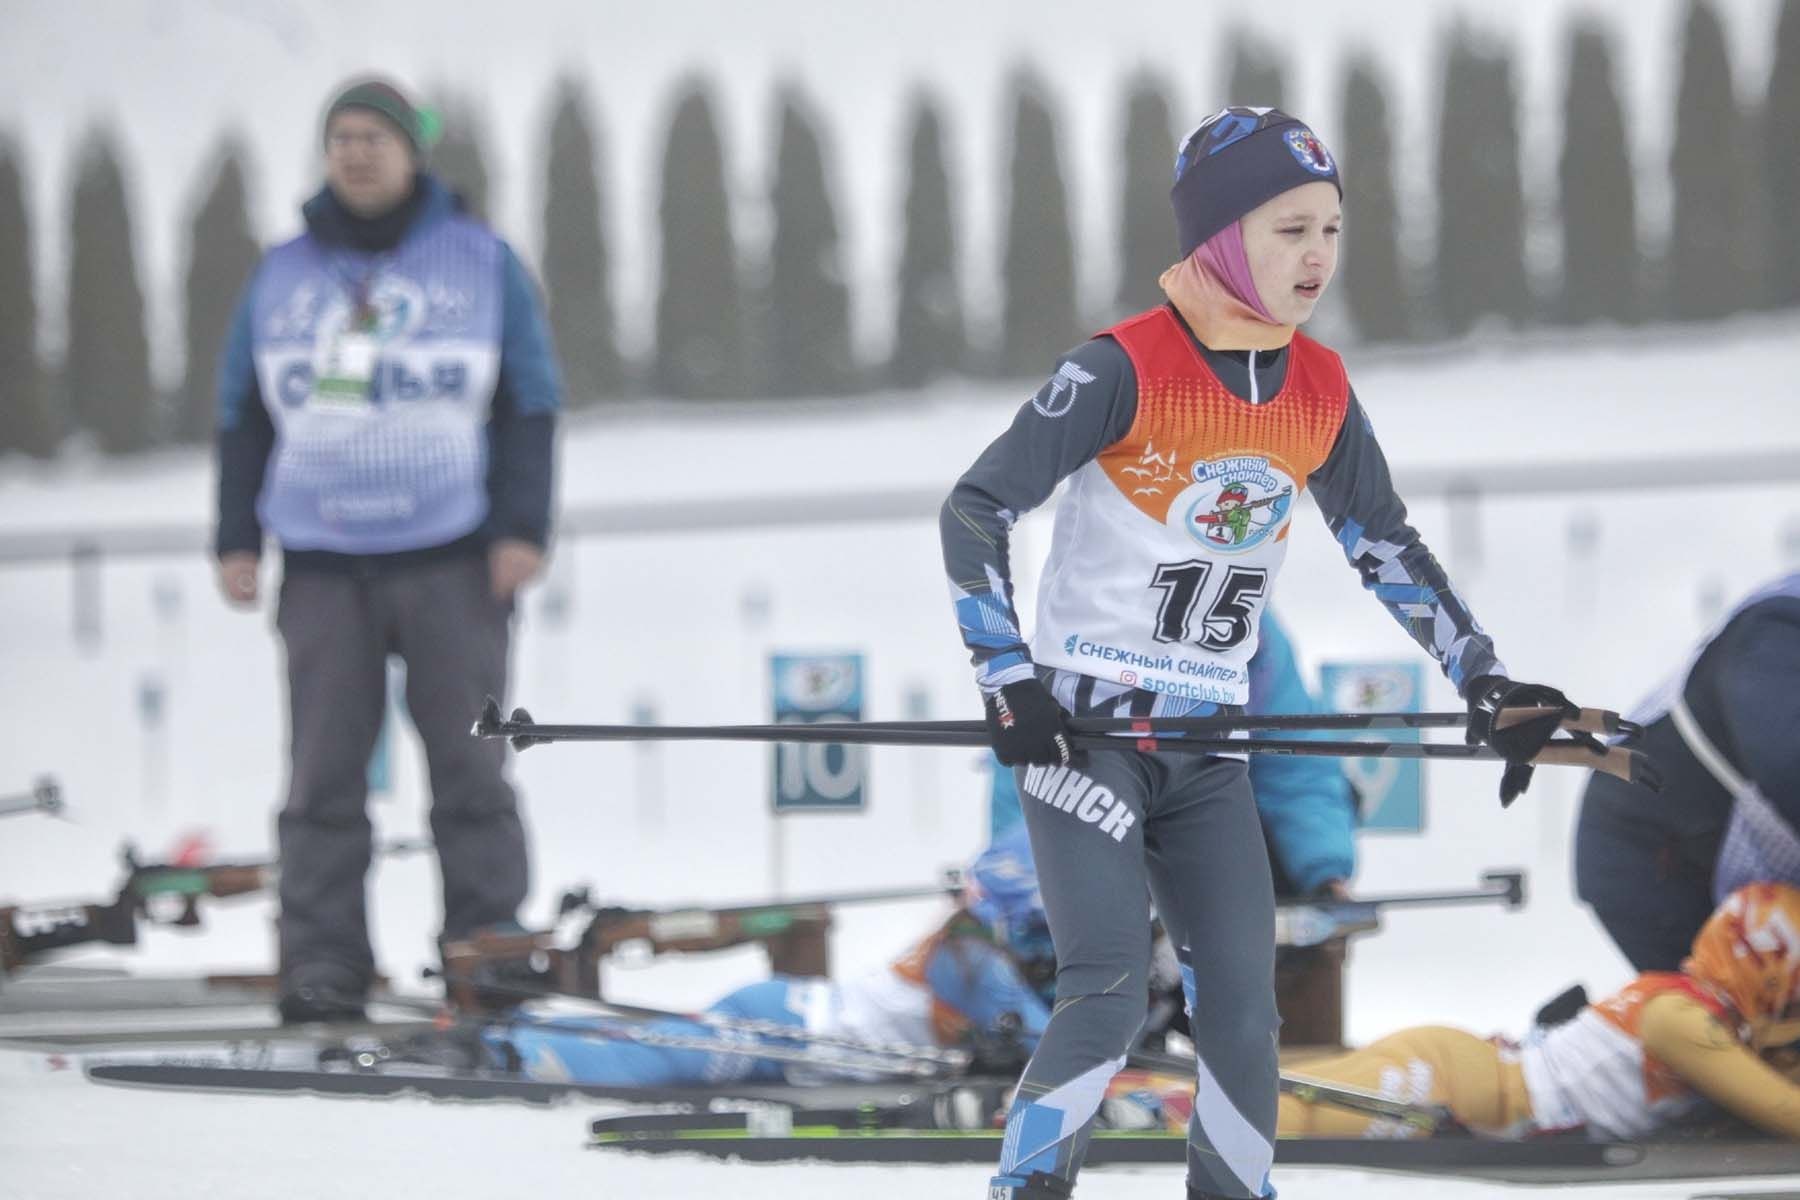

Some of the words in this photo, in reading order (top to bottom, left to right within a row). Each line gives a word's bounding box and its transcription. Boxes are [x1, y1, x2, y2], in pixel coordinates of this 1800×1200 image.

[1148, 558, 1267, 653] 15
[1079, 641, 1172, 672] СНЕЖНЫЙ
[1178, 658, 1237, 683] СНАЙПЕР
[1142, 677, 1236, 704] sportclub.by
[779, 713, 861, 800] 10
[1024, 762, 1136, 842] МИНСК
